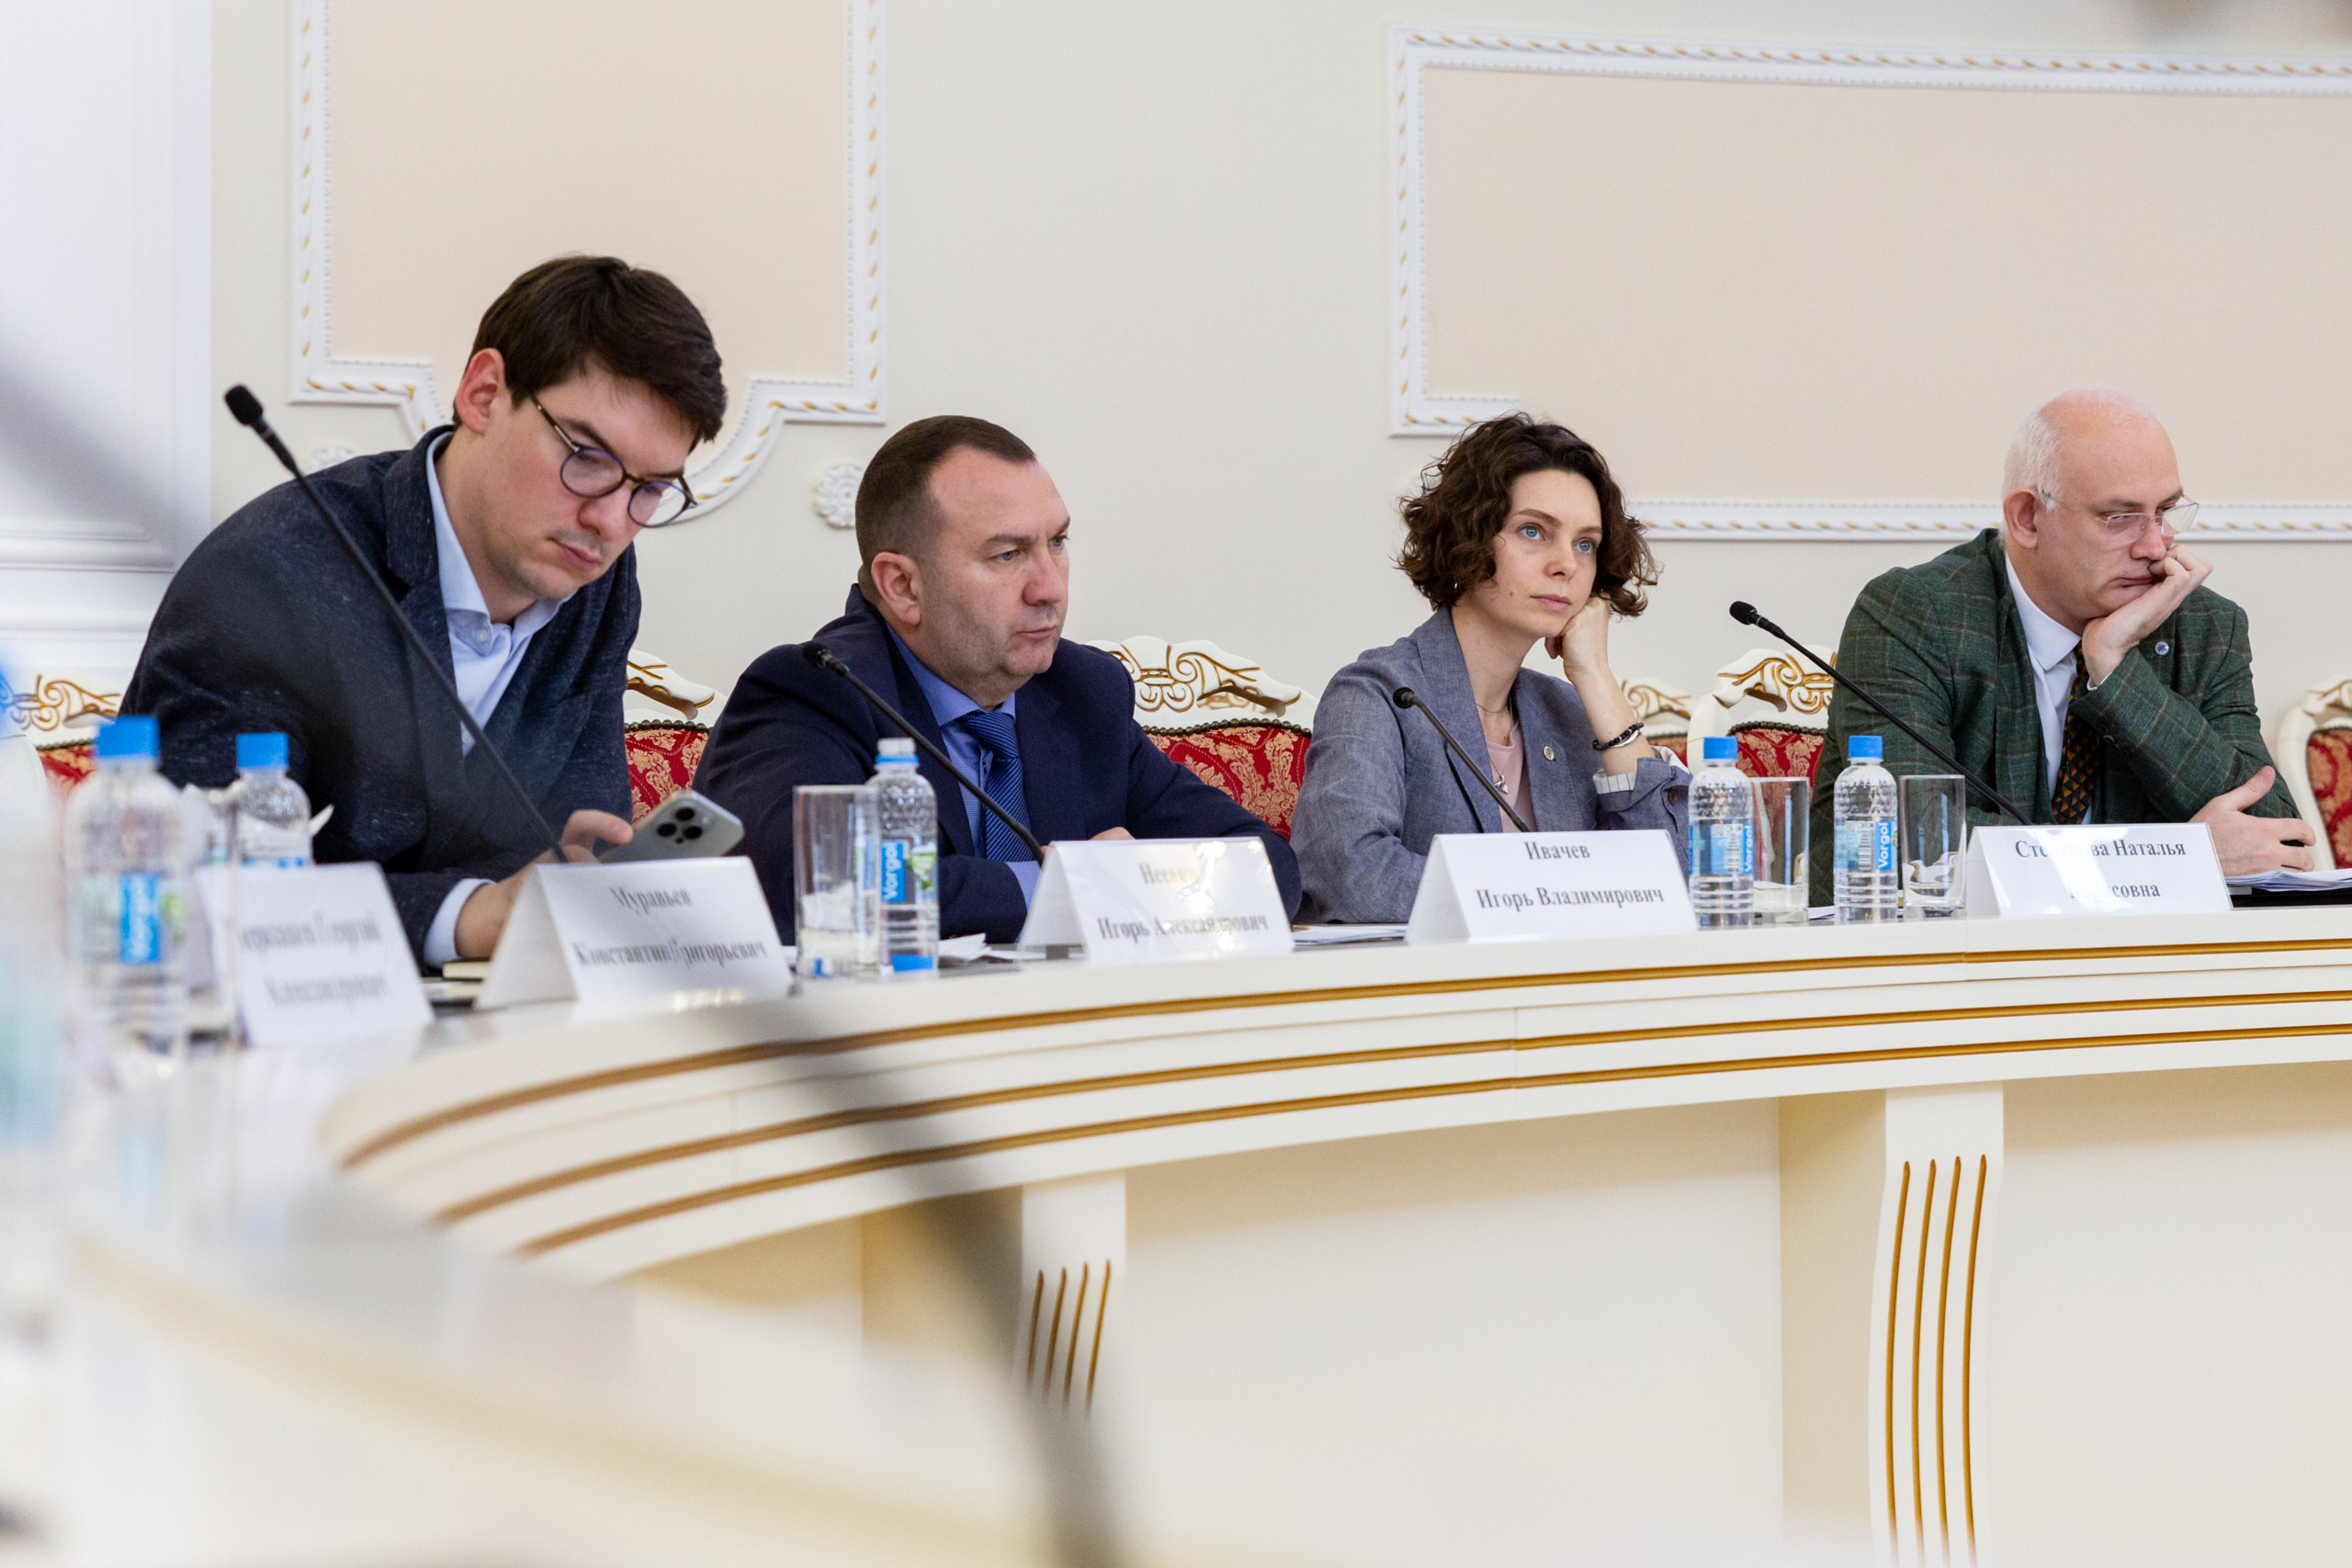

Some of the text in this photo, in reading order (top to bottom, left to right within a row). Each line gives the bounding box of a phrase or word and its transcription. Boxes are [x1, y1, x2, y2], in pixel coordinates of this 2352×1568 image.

[1523, 840, 1591, 861] Ивачев
[1744, 824, 1754, 872] Vorgol
[1877, 822, 1891, 868] Vorgol
[2015, 839, 2187, 858] Стева Наталья
[882, 841, 902, 900] Vorgol
[1476, 886, 1666, 912] Игорь Владимирович
[2070, 882, 2161, 898] совна
[1098, 917, 1150, 944] Игорь
